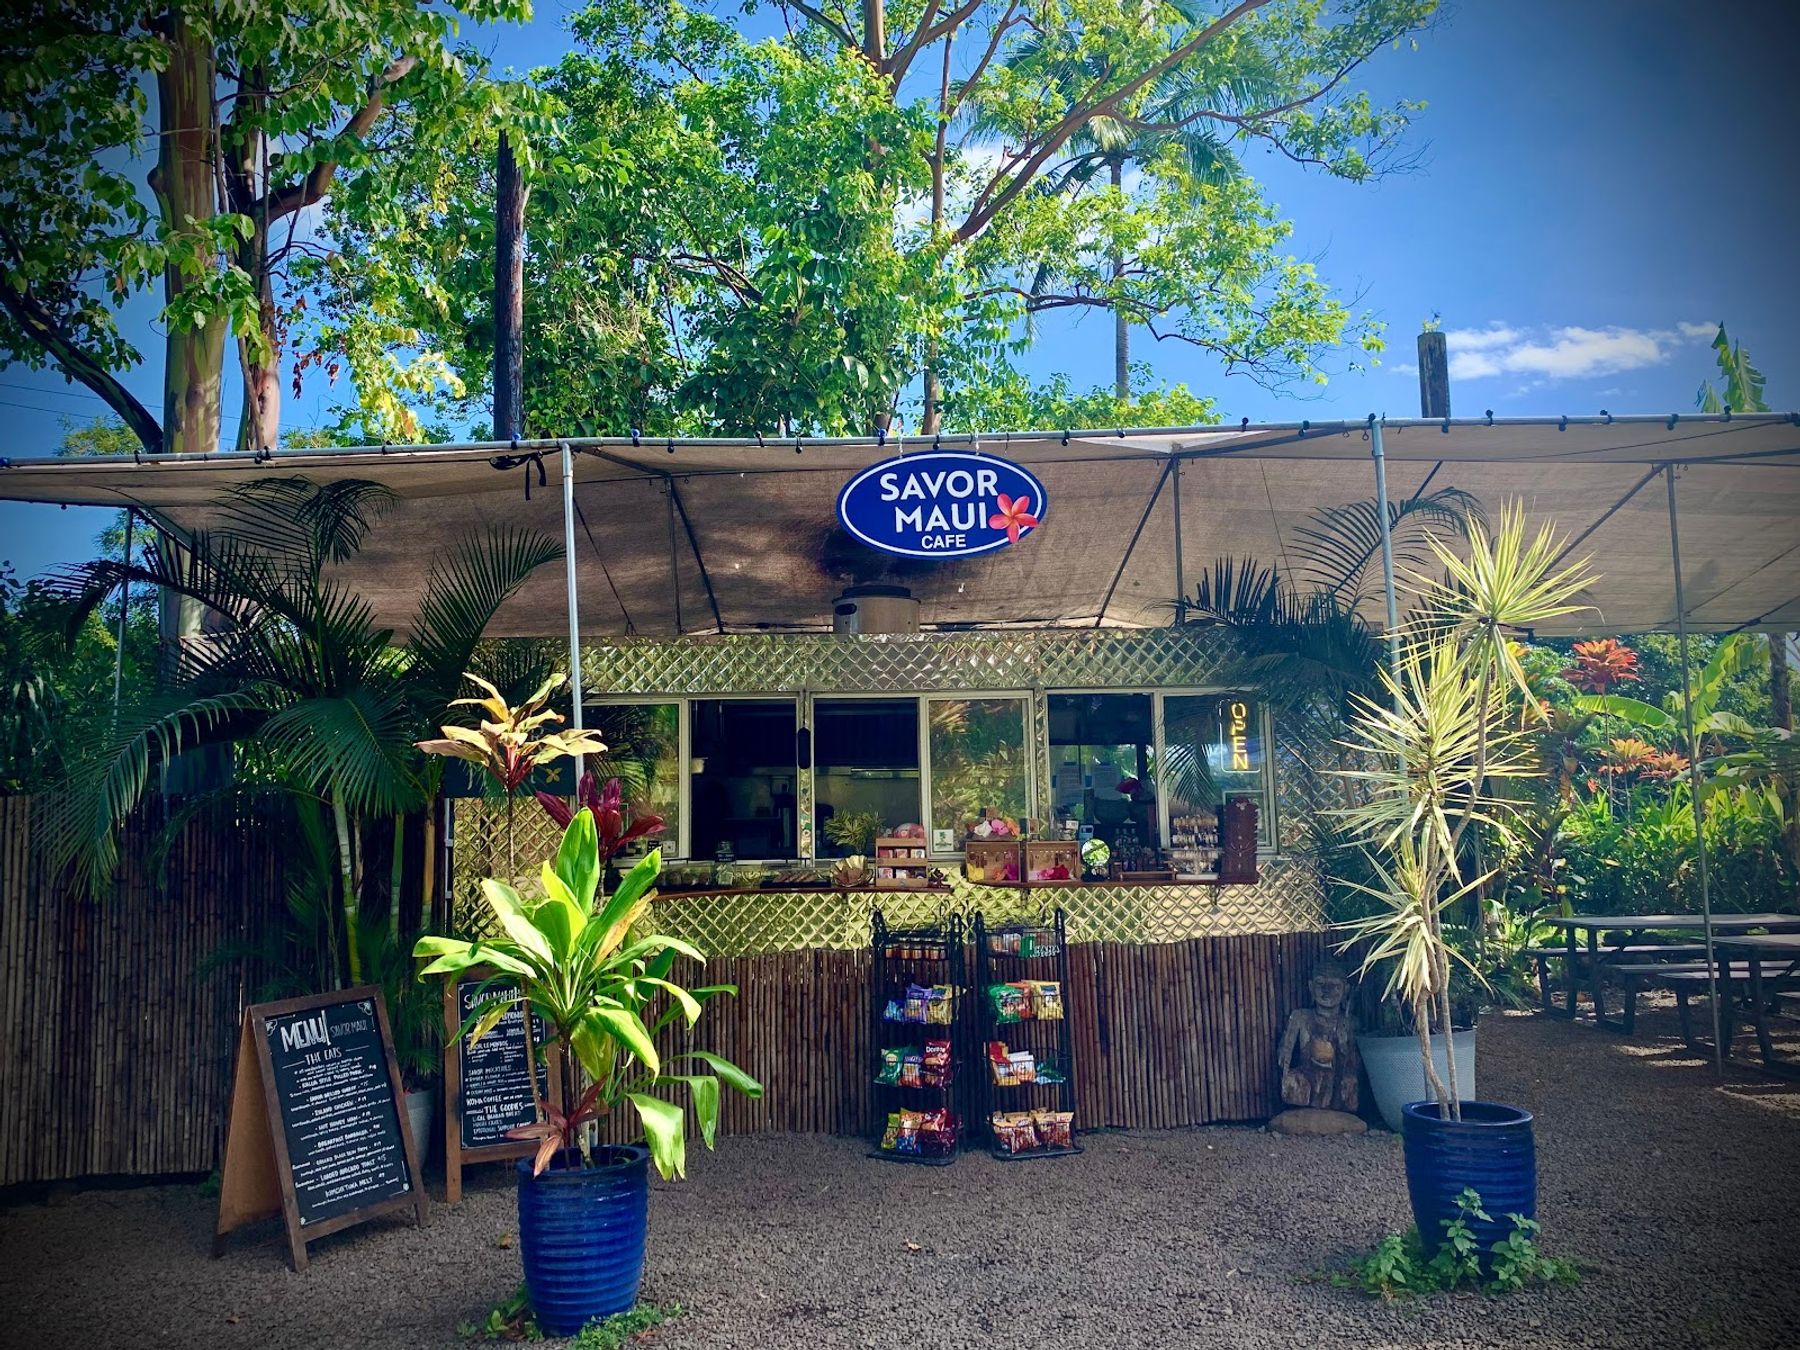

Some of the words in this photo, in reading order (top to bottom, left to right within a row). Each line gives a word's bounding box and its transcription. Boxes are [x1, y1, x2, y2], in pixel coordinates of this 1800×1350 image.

[880, 469, 998, 501] SAVOR
[895, 502, 987, 533] MAUI
[921, 534, 966, 549] CAFE
[1230, 703, 1248, 770] OPEN
[280, 1010, 331, 1052] MENU
[305, 1053, 321, 1065] THE
[324, 1047, 342, 1060] EATS
[484, 1104, 498, 1114] THE
